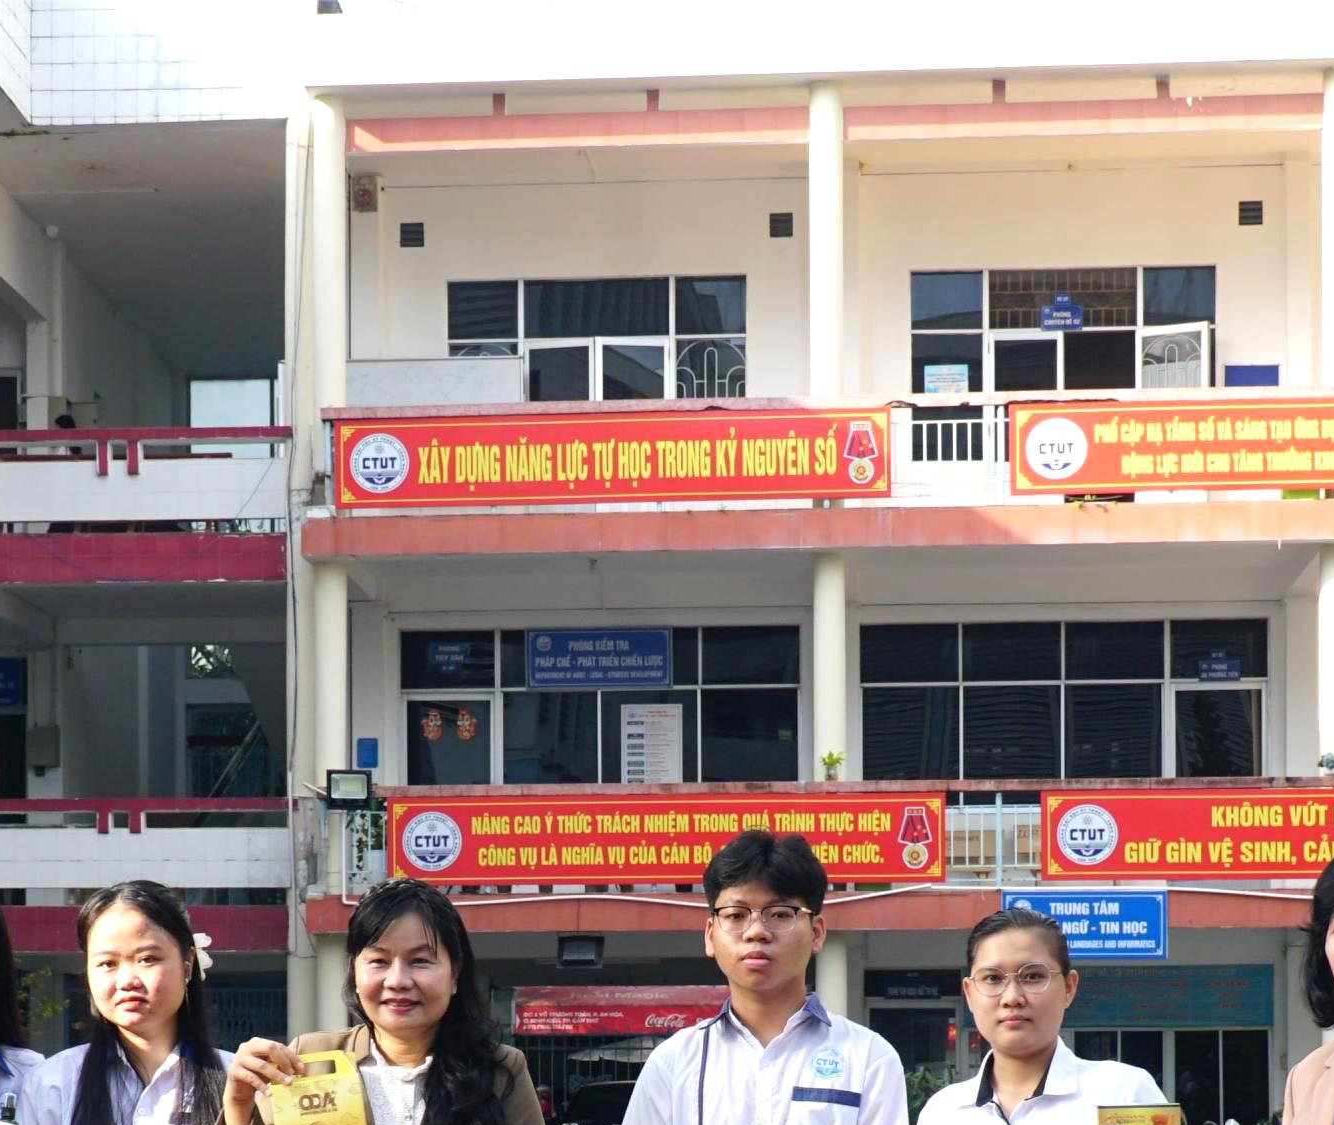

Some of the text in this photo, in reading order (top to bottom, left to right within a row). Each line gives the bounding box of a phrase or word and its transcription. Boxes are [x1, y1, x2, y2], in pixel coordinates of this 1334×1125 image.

[1121, 421, 1145, 446] CẬP
[1198, 416, 1215, 441] SỐ
[1217, 417, 1233, 441] VÀ
[1235, 416, 1267, 440] SÁNG
[1270, 419, 1292, 443] TẠO
[1039, 442, 1074, 454] CTUT
[362, 456, 398, 470] CTUT
[418, 423, 837, 491] XÂY DỰNG NĂNG LỰC TỰ HỌC TRONG KỶ NGUYÊN SỐ
[1156, 451, 1179, 478] LỰC
[1233, 449, 1264, 472] TĂNG
[535, 655, 556, 667] PHÁP
[577, 654, 597, 667] PHÁT
[1211, 802, 1283, 827] KHÔNG
[1289, 801, 1328, 826] VỨT
[471, 810, 891, 837] NÂNG CAO Ý THỨC TRÁCH NHIỆM TRONG QUÁ TRÌNH THỰC HIỆN
[414, 835, 449, 848] CTUT
[1070, 828, 1105, 841] CTUT
[478, 844, 516, 866] CÔNG
[519, 848, 538, 869] VỤ
[541, 843, 558, 865] LÀ
[561, 843, 603, 865] NGHĨA
[607, 847, 626, 869] VỤ
[629, 840, 657, 864] CỦA
[661, 841, 689, 864] CÁN
[842, 843, 884, 864] CHỨC.
[1124, 838, 1162, 863] GIỮ
[1165, 838, 1202, 863] GÌN
[1207, 837, 1233, 867] VỆ
[1240, 841, 1297, 865] SINH,
[1049, 899, 1119, 915] TRUNG TÂM
[1062, 919, 1147, 936] NGỮ TIN HỌC
[1070, 939, 1156, 948] LANGUAGES AND INFORMATICS
[816, 1058, 839, 1069] CTUT
